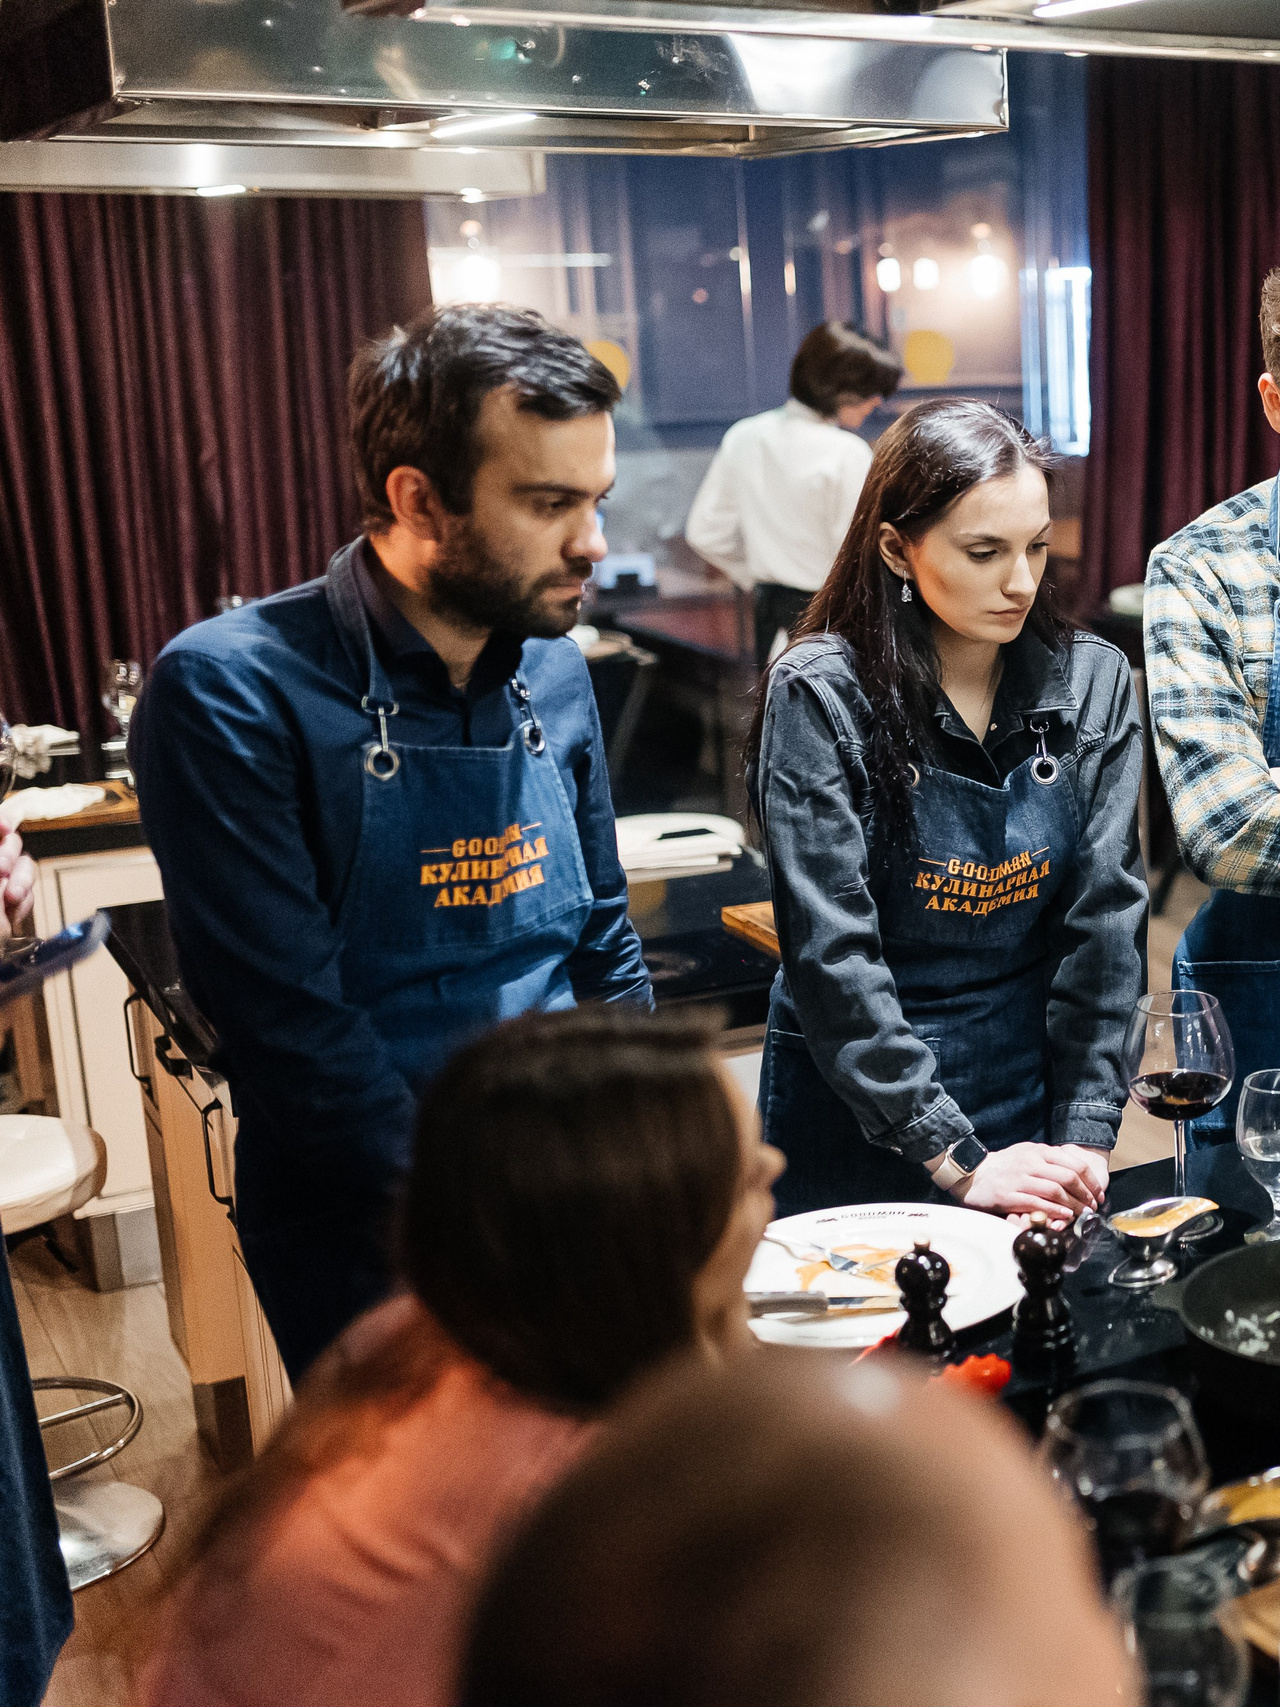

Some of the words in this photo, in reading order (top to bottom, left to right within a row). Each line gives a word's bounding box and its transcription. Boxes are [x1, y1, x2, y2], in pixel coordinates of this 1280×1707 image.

[914, 859, 1051, 899] КУЛИНАРНАЯ
[947, 850, 1033, 882] GOODMAN
[924, 883, 1040, 917] АКАДЕМИЯ
